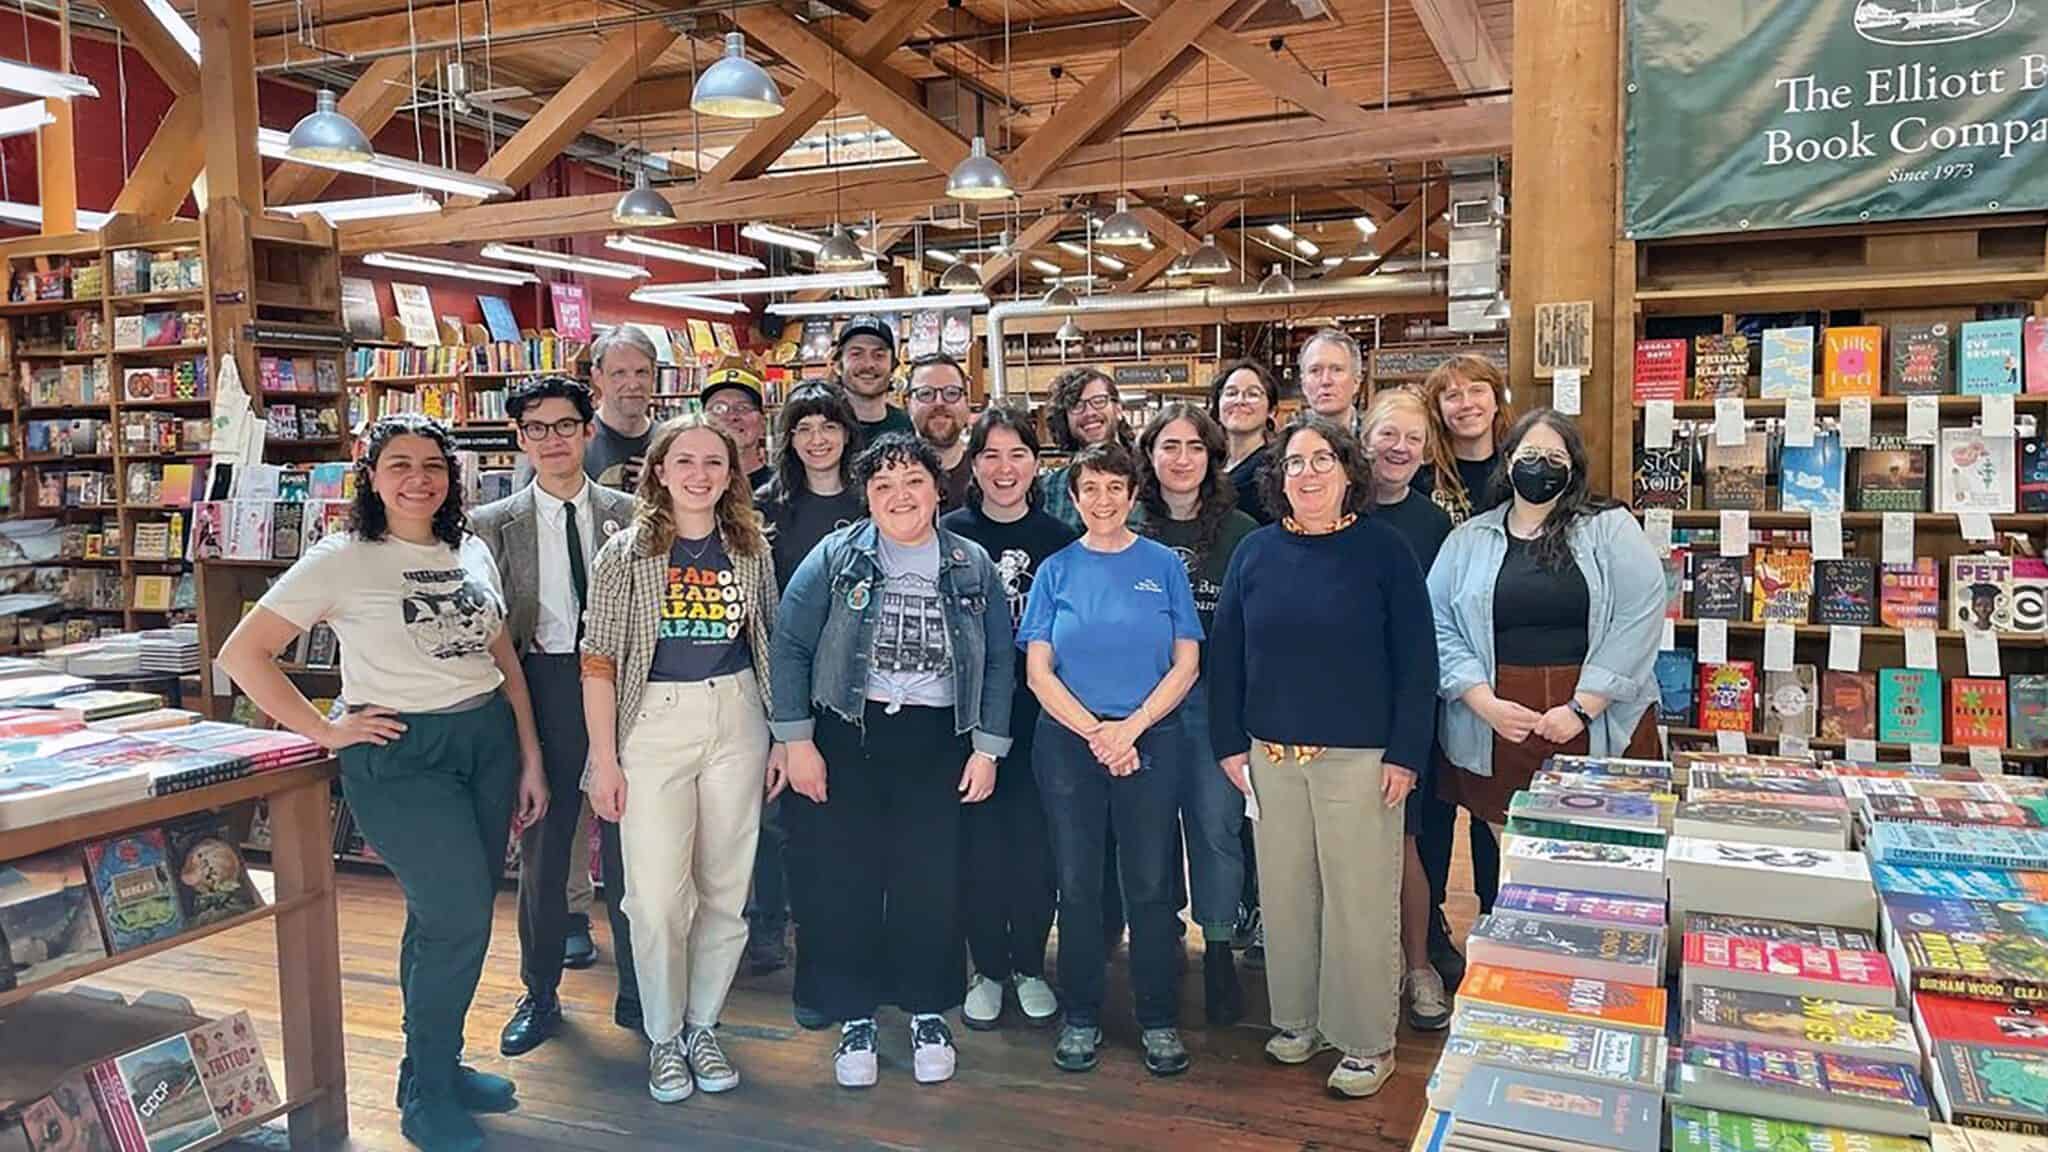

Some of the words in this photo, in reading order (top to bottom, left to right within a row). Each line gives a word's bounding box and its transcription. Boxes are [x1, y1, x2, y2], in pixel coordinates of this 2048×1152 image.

[1775, 73, 1852, 114] The
[1865, 61, 2006, 107] Elliott
[1763, 120, 1876, 165] Book
[1889, 115, 2048, 158] Compa
[1887, 165, 1929, 184] Since
[1933, 162, 1974, 181] 1973
[1695, 353, 1747, 364] FRIDAY
[1695, 364, 1748, 376] BLACK
[1643, 456, 1681, 472] SUN
[1640, 475, 1684, 492] VOID
[666, 566, 739, 586] EADO
[1956, 565, 2010, 581] PET
[666, 583, 746, 603] EADO
[660, 601, 746, 620] EADO
[1893, 848, 1943, 861] COMMUNITY
[1919, 977, 1965, 994] BIRNAM
[1967, 981, 2003, 996] WOOD
[208, 1048, 251, 1077] TATTOO
[139, 1081, 169, 1118] CCCP
[1964, 1115, 2018, 1132] STONE
